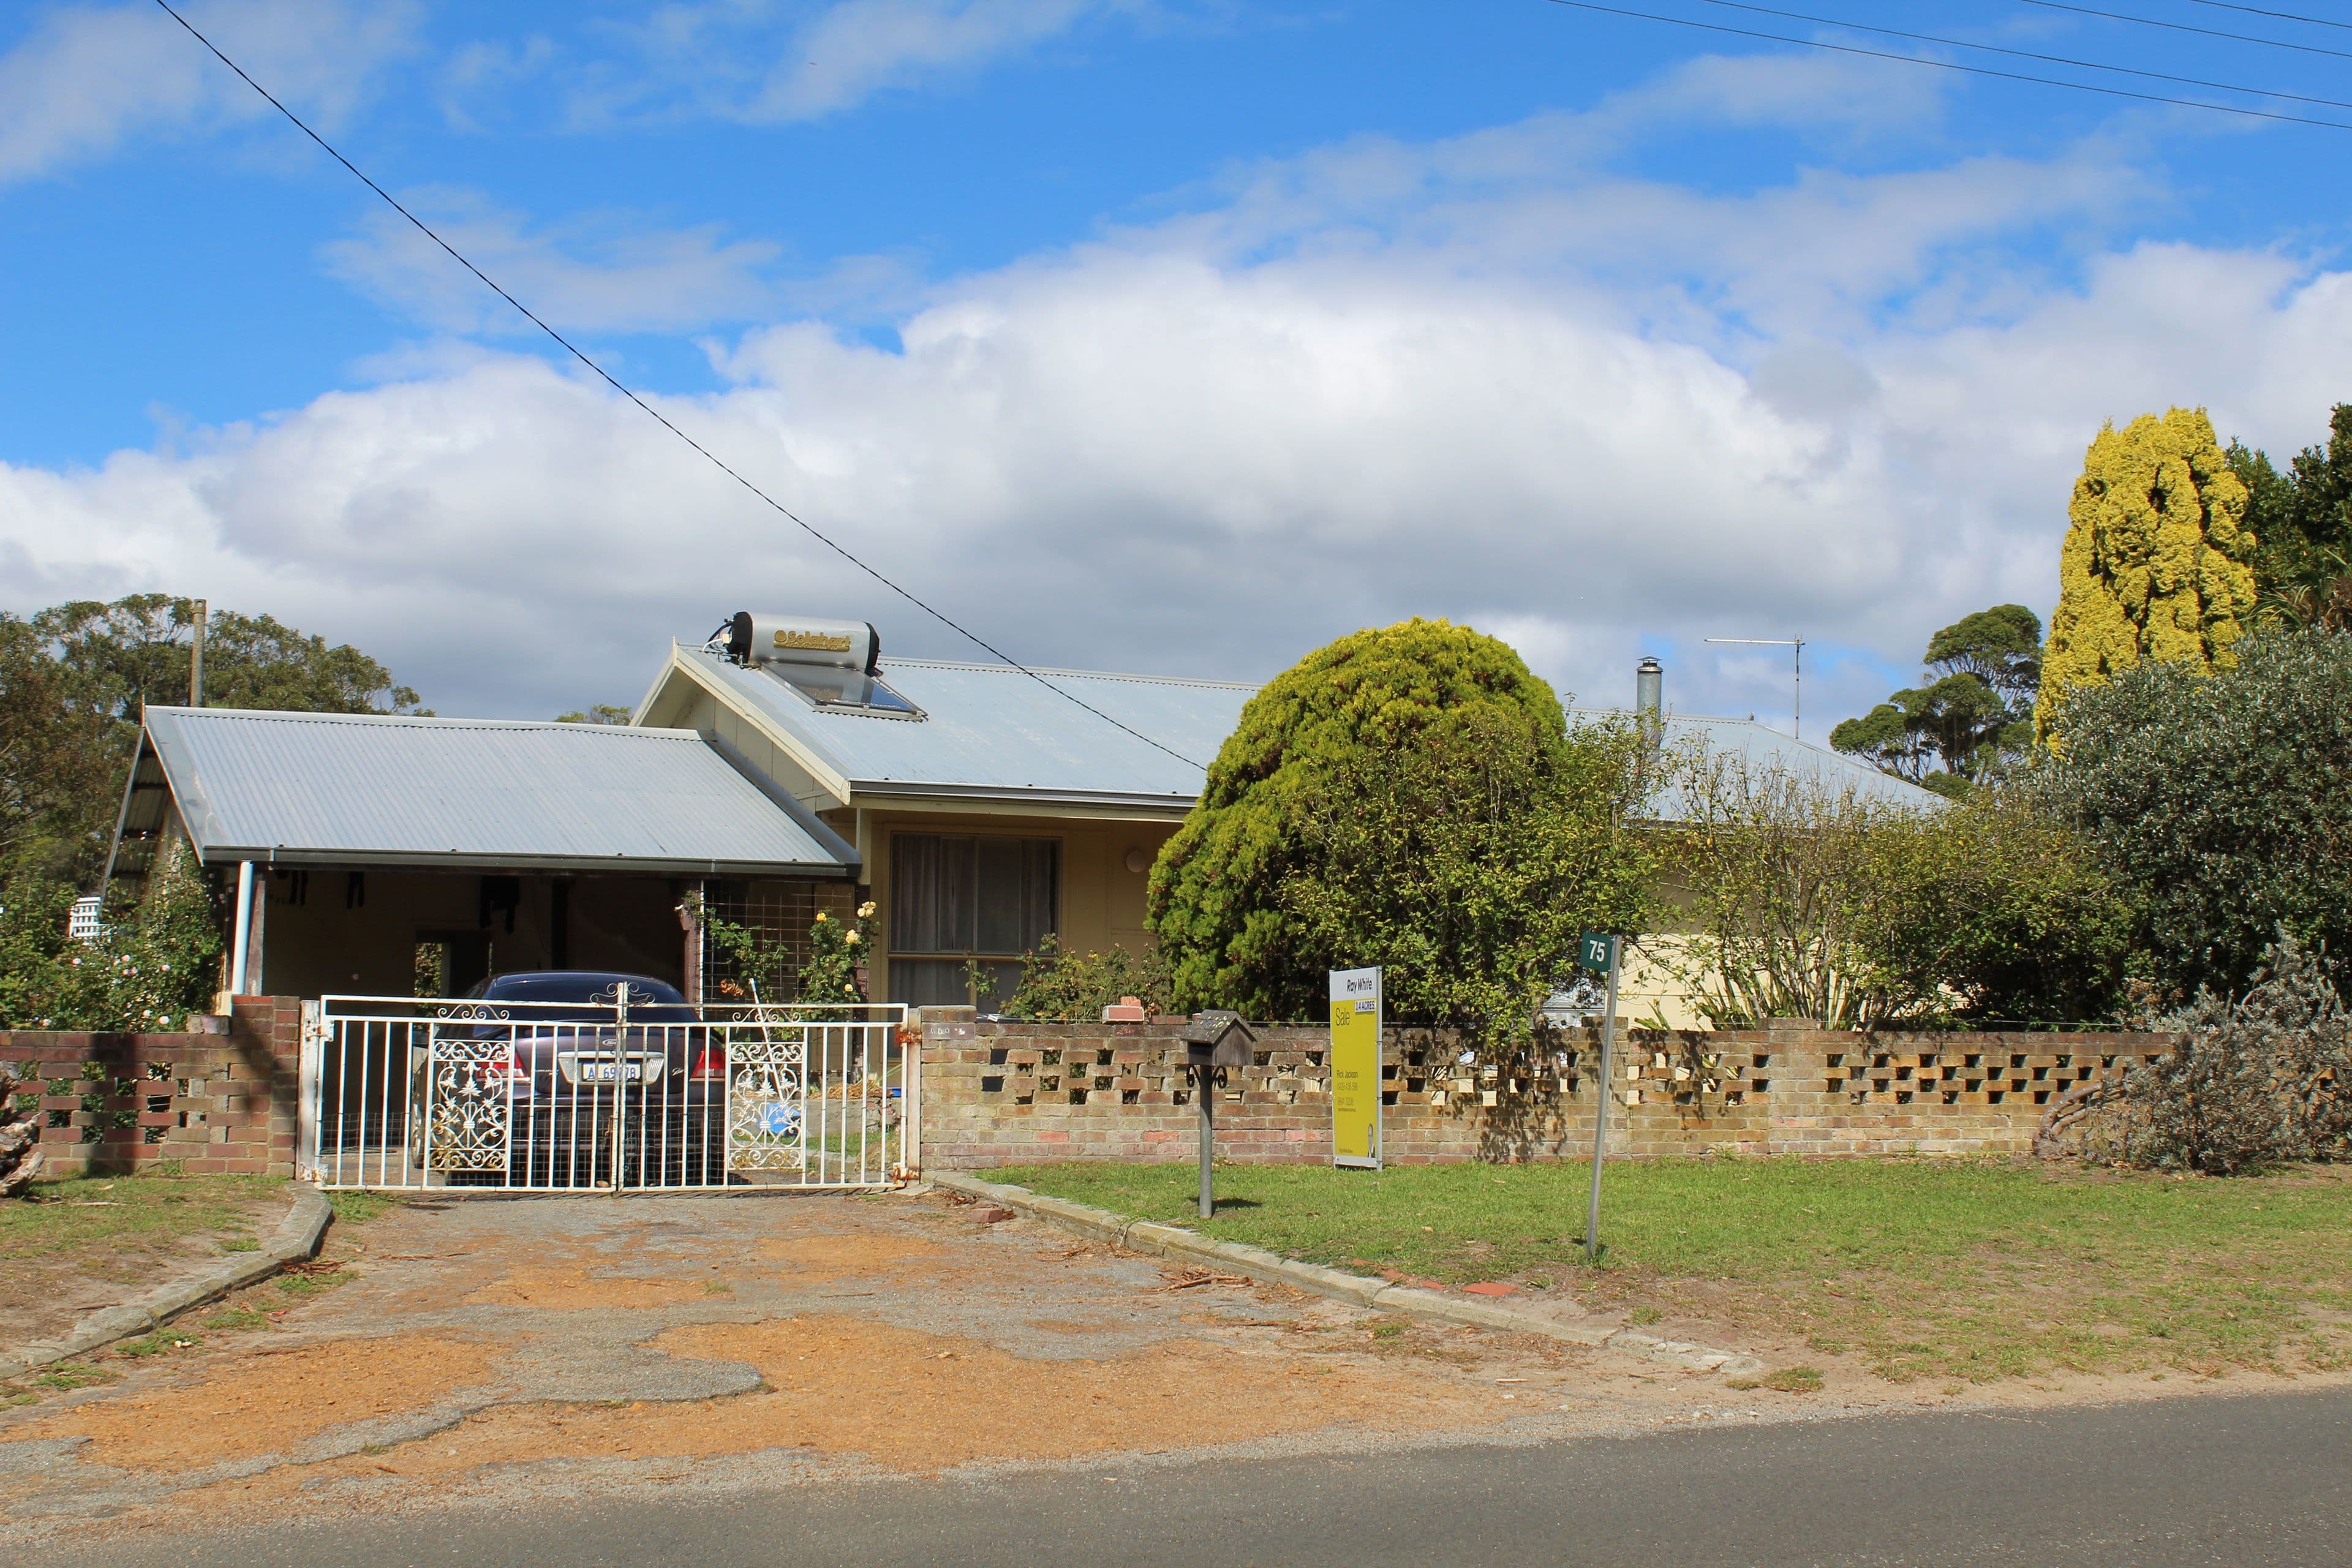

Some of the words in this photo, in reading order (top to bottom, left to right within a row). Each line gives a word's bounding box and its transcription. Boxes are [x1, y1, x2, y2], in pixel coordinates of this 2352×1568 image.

[787, 631, 850, 646] Solahart
[1589, 940, 1605, 962] 75
[1347, 979, 1357, 993] Ray
[1358, 978, 1372, 991] White
[1362, 1001, 1375, 1010] ACRES
[1335, 1007, 1350, 1026] Sale
